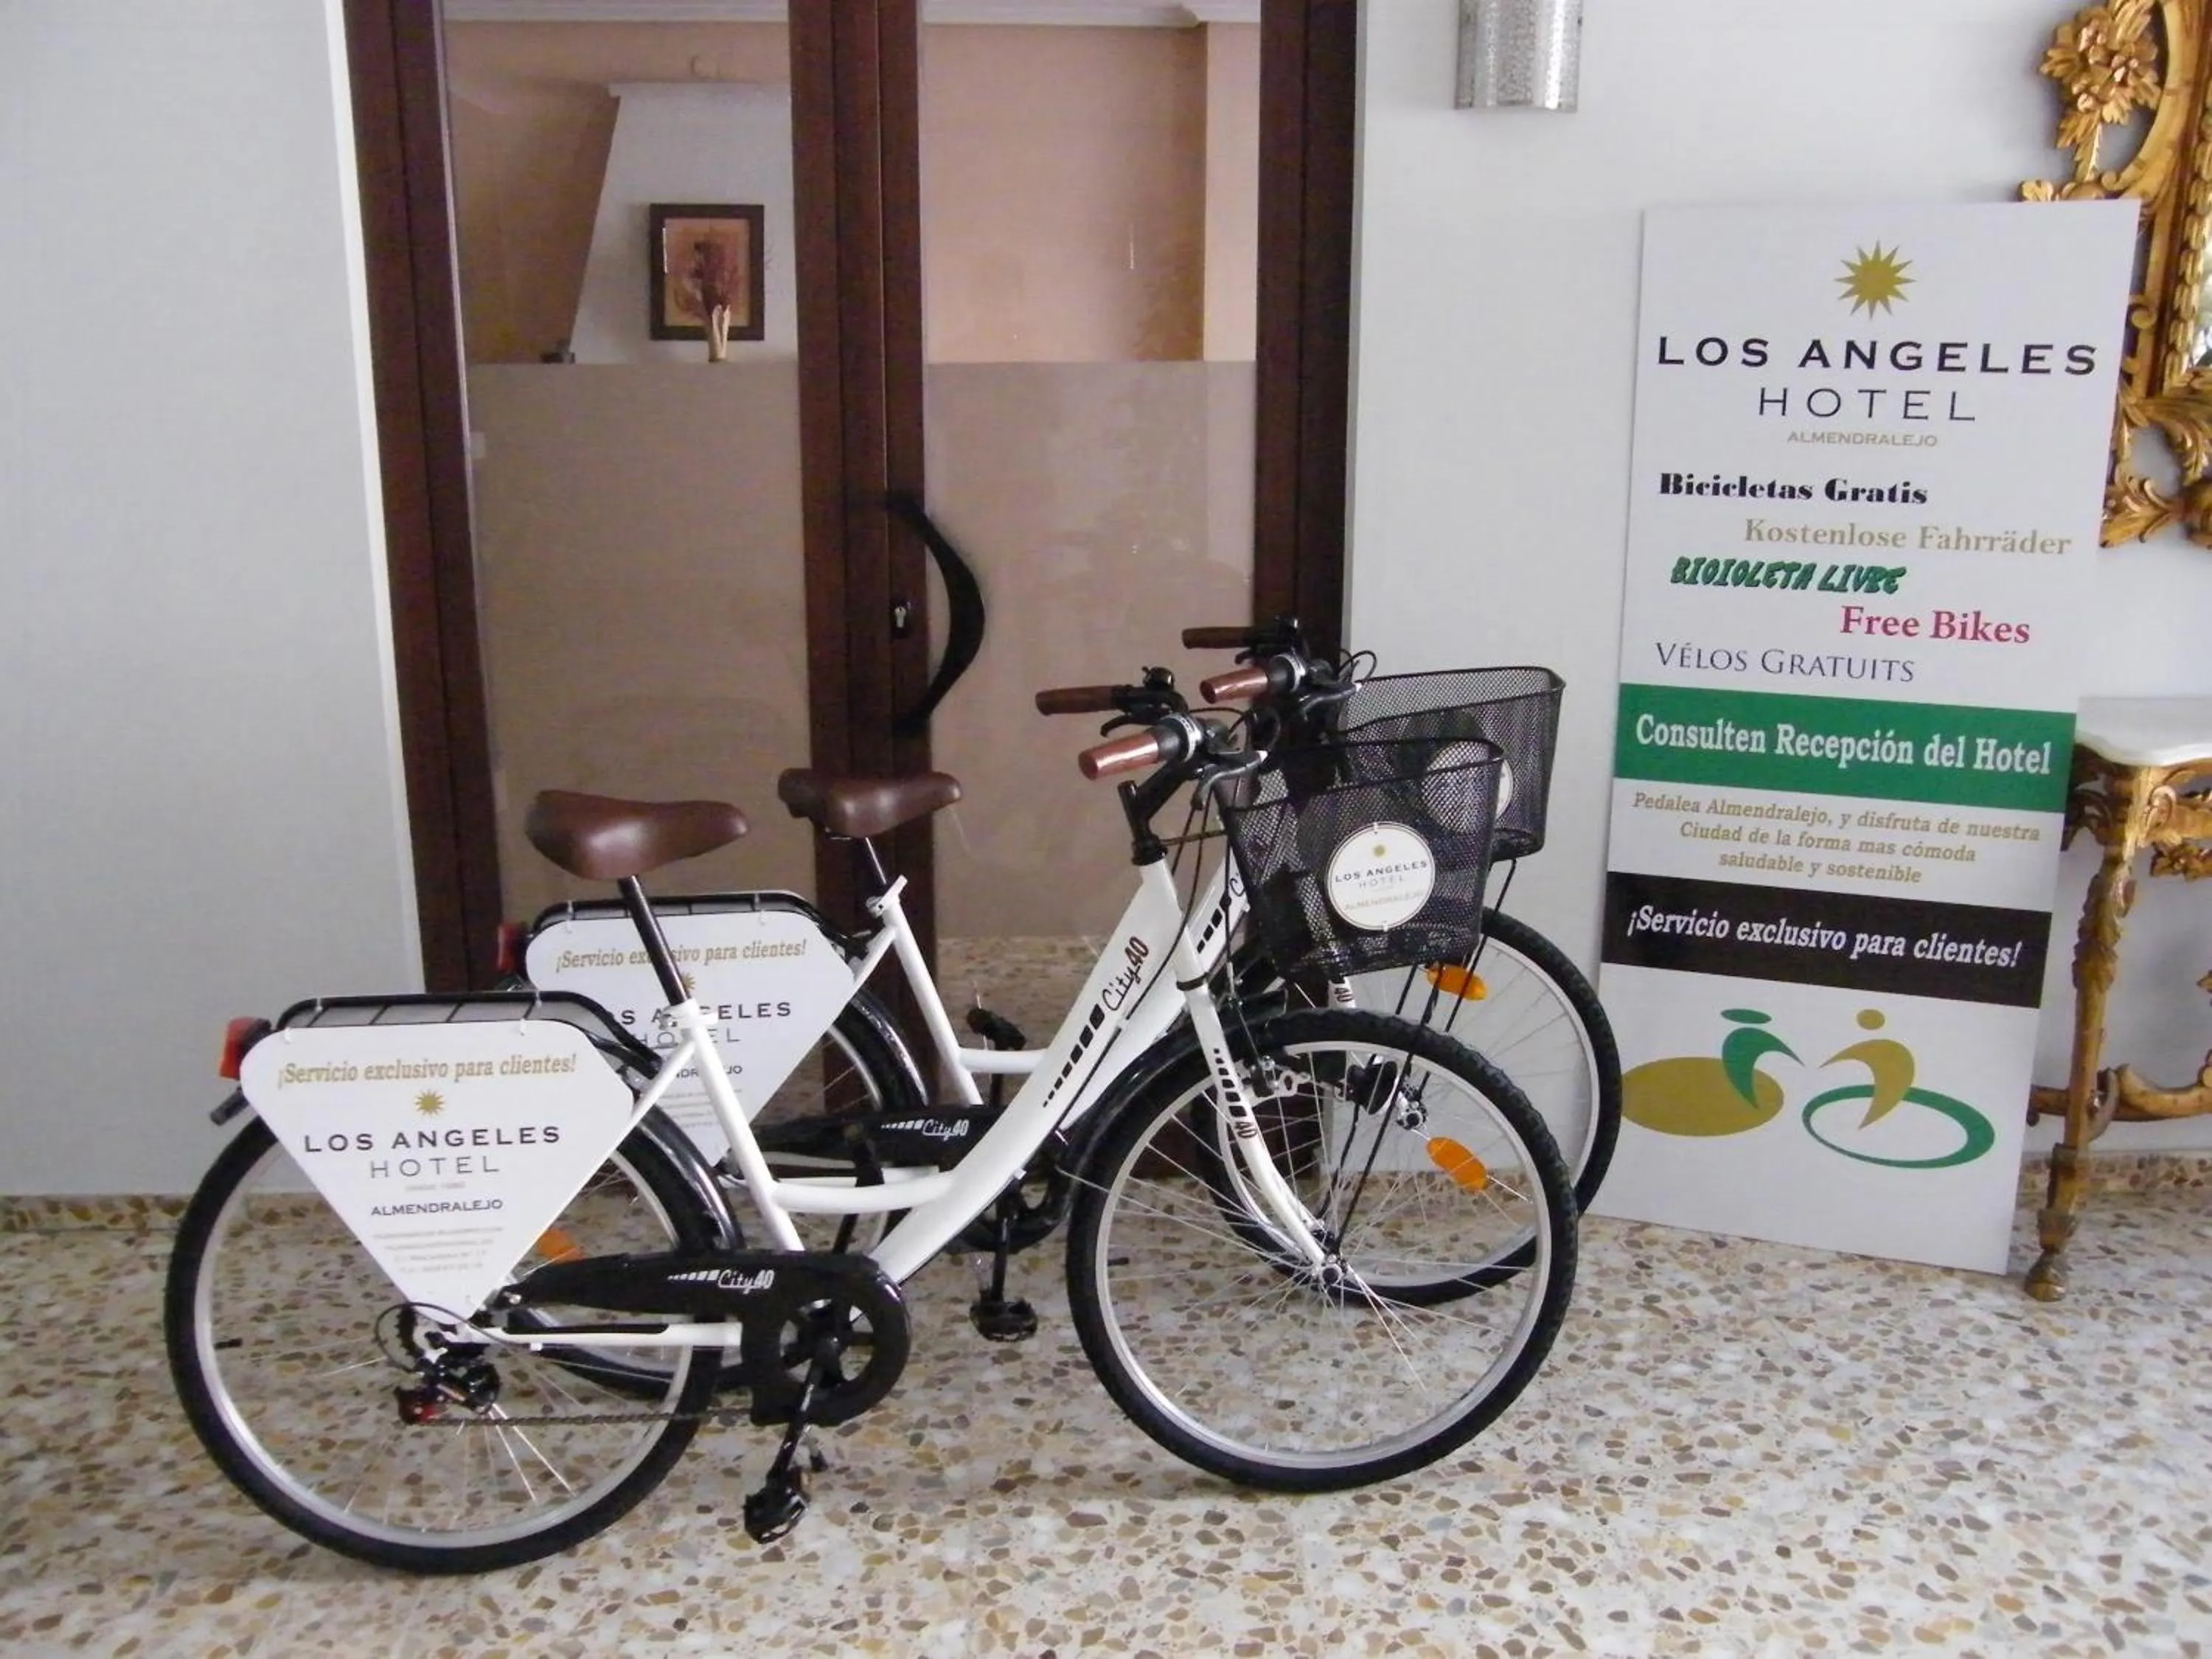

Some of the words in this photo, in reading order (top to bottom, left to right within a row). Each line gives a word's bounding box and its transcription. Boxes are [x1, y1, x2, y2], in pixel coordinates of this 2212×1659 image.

[1658, 336, 1769, 367] LOS
[1798, 338, 2096, 376] ANGELES
[1759, 387, 1976, 421] HOTEL
[1787, 431, 1938, 448] ALMENDRALEJO
[1659, 473, 1812, 501] Bicicletas
[1824, 478, 1928, 504] Gratis
[1745, 518, 1907, 549] Kostenlose
[1917, 525, 2073, 555] Fahrräder
[1840, 605, 1920, 637] Free
[1930, 610, 2031, 644] Bikes
[1655, 642, 1747, 672] VÉLOS
[1761, 649, 1915, 683] GRATUITS
[1635, 713, 1767, 754] Consulten
[1774, 723, 1914, 768] Recepción
[1924, 733, 1966, 768] del
[1973, 737, 2052, 775] Hotel
[1632, 791, 1701, 814] Pedalea
[1706, 798, 1833, 827] Almendralejo,
[1839, 812, 1852, 830] y
[1857, 810, 1932, 833] disfruta
[1937, 817, 1961, 836] de
[1966, 822, 2041, 842] nuestra
[1680, 821, 1742, 843] Ciudad
[1747, 827, 1769, 846] de
[1775, 829, 1792, 847] la
[1797, 830, 1851, 852] forma
[1857, 838, 1897, 855] mas
[1902, 839, 1977, 862] cómoda
[1719, 851, 1805, 874] saludable
[1809, 861, 1821, 878] y
[1826, 861, 1922, 885] sostenible
[629, 945, 700, 965] exsivo
[703, 945, 737, 965] para
[742, 939, 807, 959] clientes!
[1627, 905, 1730, 939] ¡Servicio
[1736, 917, 1846, 951] exclusivo
[1851, 933, 1906, 959] para
[1913, 933, 2023, 968] clientes!
[277, 1061, 359, 1089] ¡Servicio
[364, 1057, 448, 1082] exclusivo
[454, 1061, 495, 1083] para
[500, 1053, 577, 1077] clientes!
[305, 1132, 375, 1153] LOS
[391, 1125, 561, 1150] ANGELES
[370, 1156, 500, 1179] HOTEL
[371, 1198, 504, 1217] ALMENDRALEJO
[717, 1269, 775, 1294] City40
